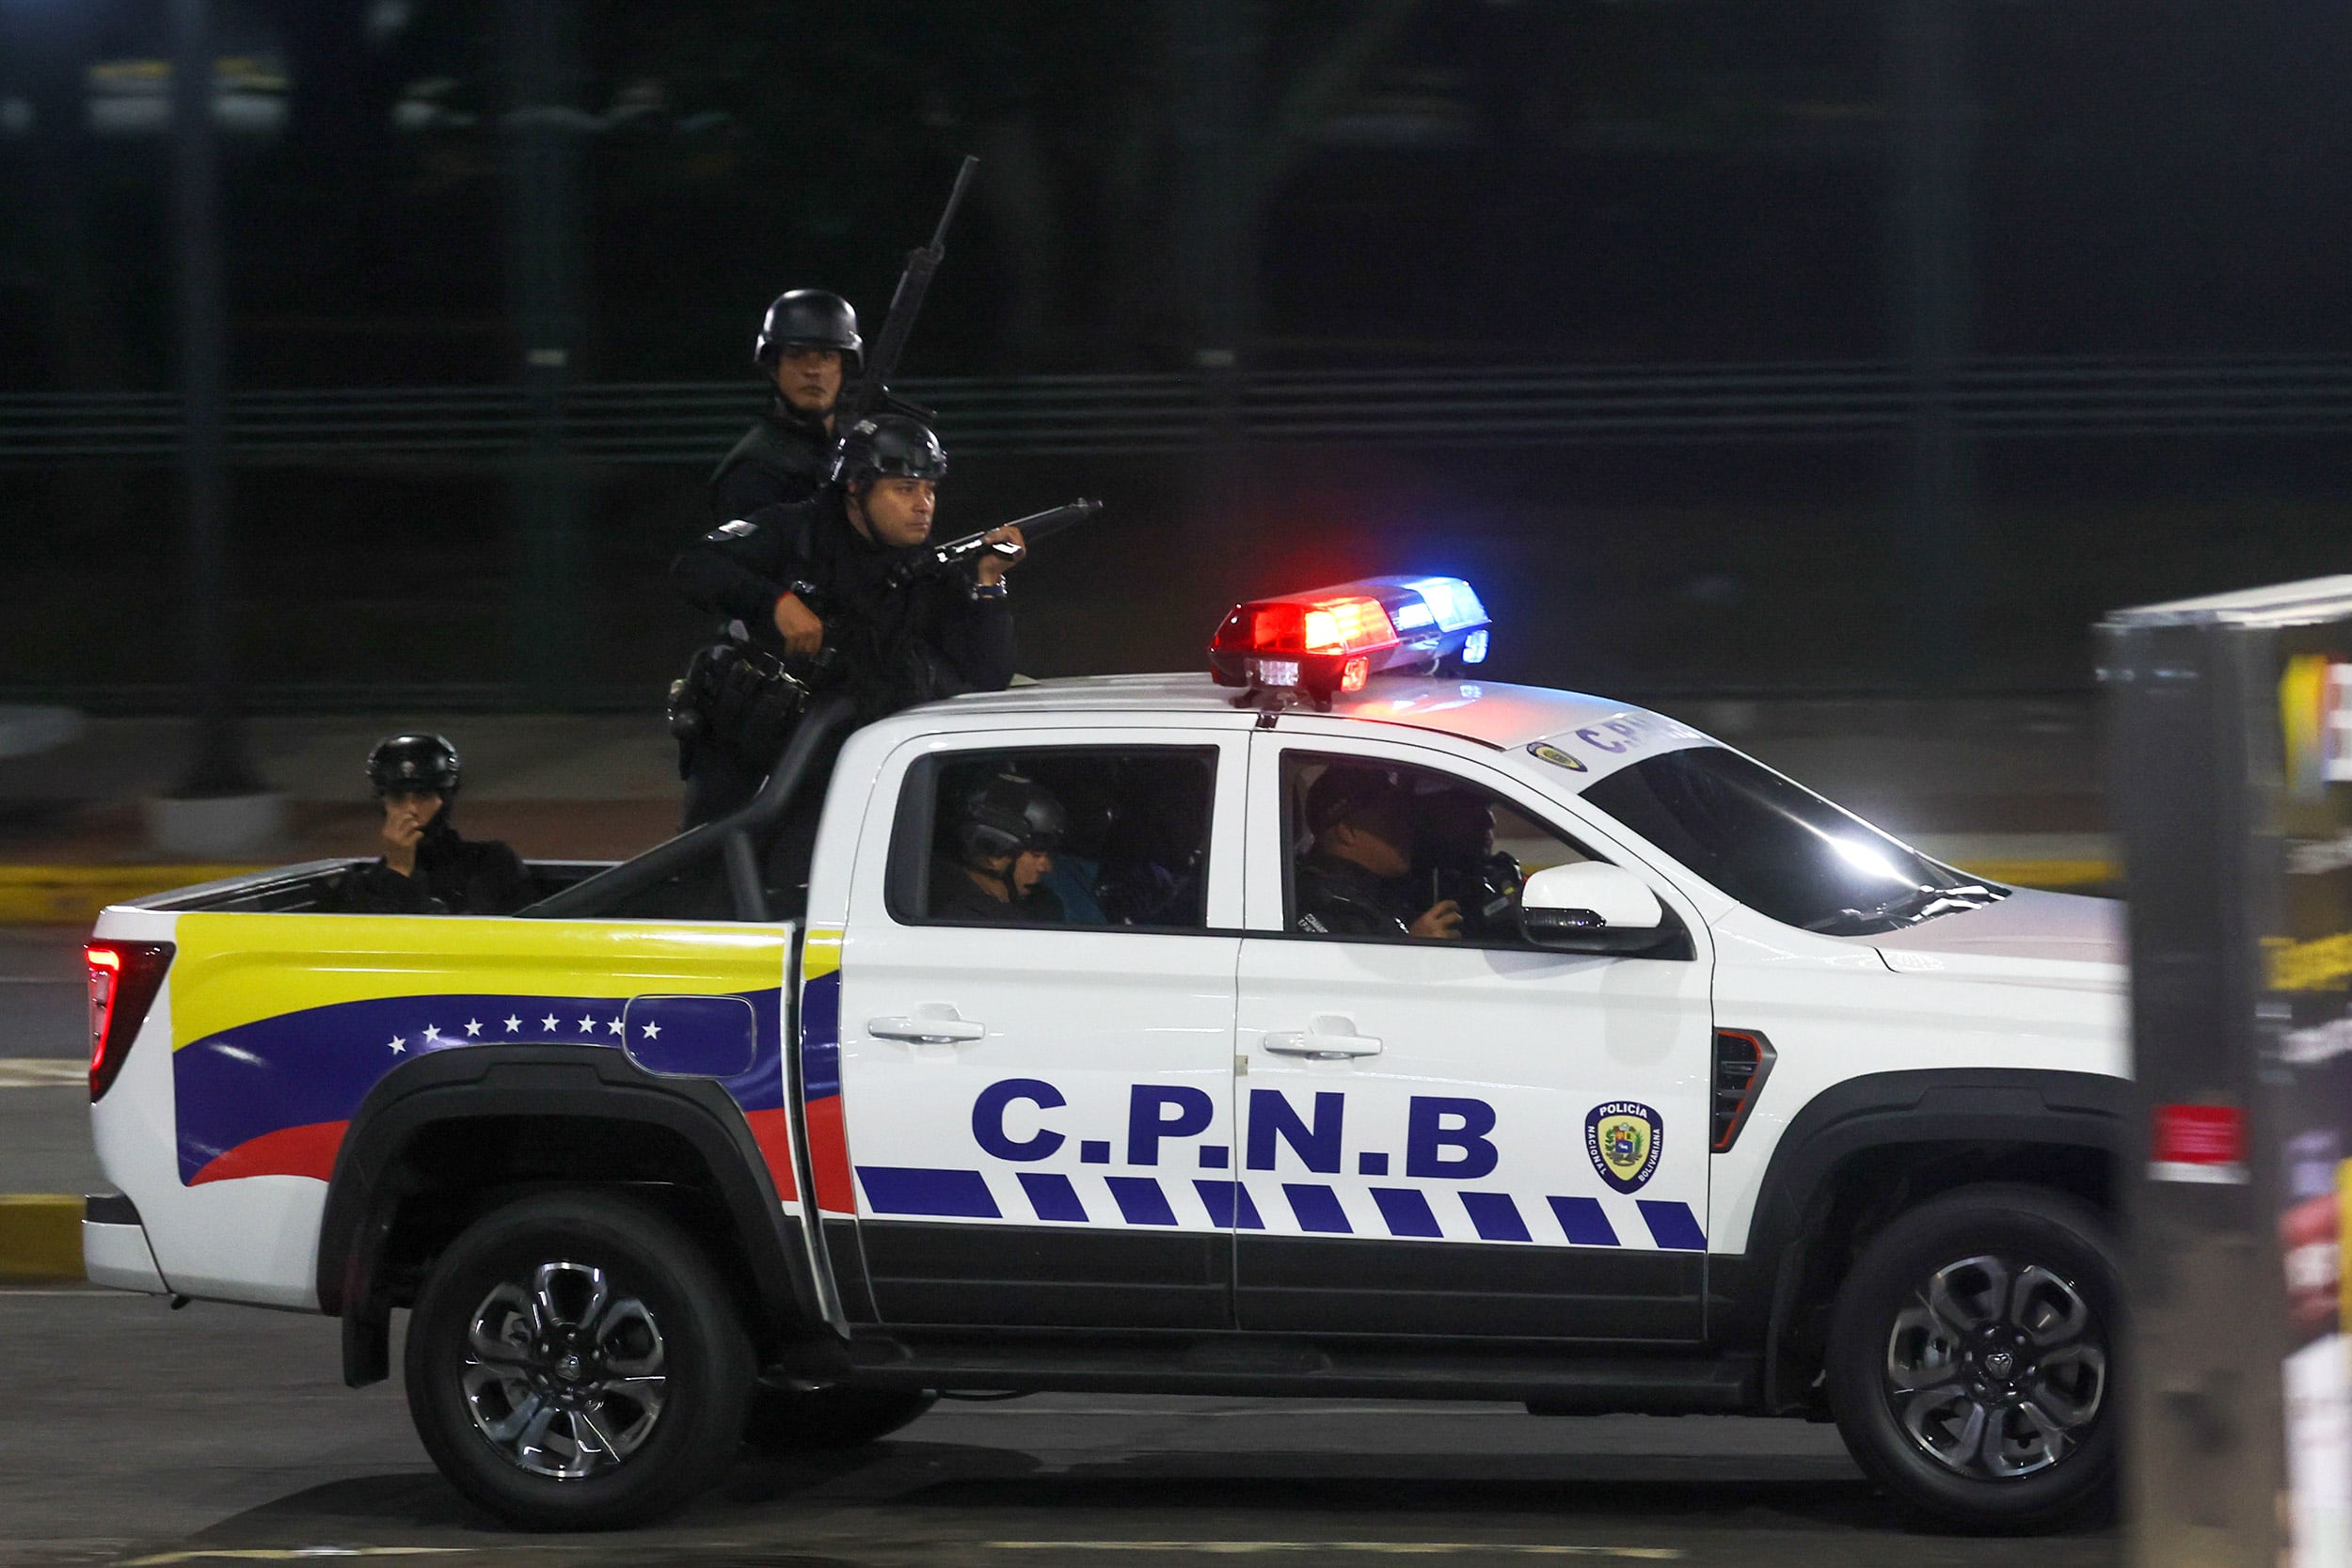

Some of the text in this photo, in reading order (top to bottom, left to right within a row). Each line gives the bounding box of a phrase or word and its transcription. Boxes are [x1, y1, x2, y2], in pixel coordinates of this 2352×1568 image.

[971, 1078, 1499, 1180] C.P.N.B
[1587, 1125, 1607, 1176] NACIONAL
[1637, 1128, 1661, 1182] BOLIVARIANA
